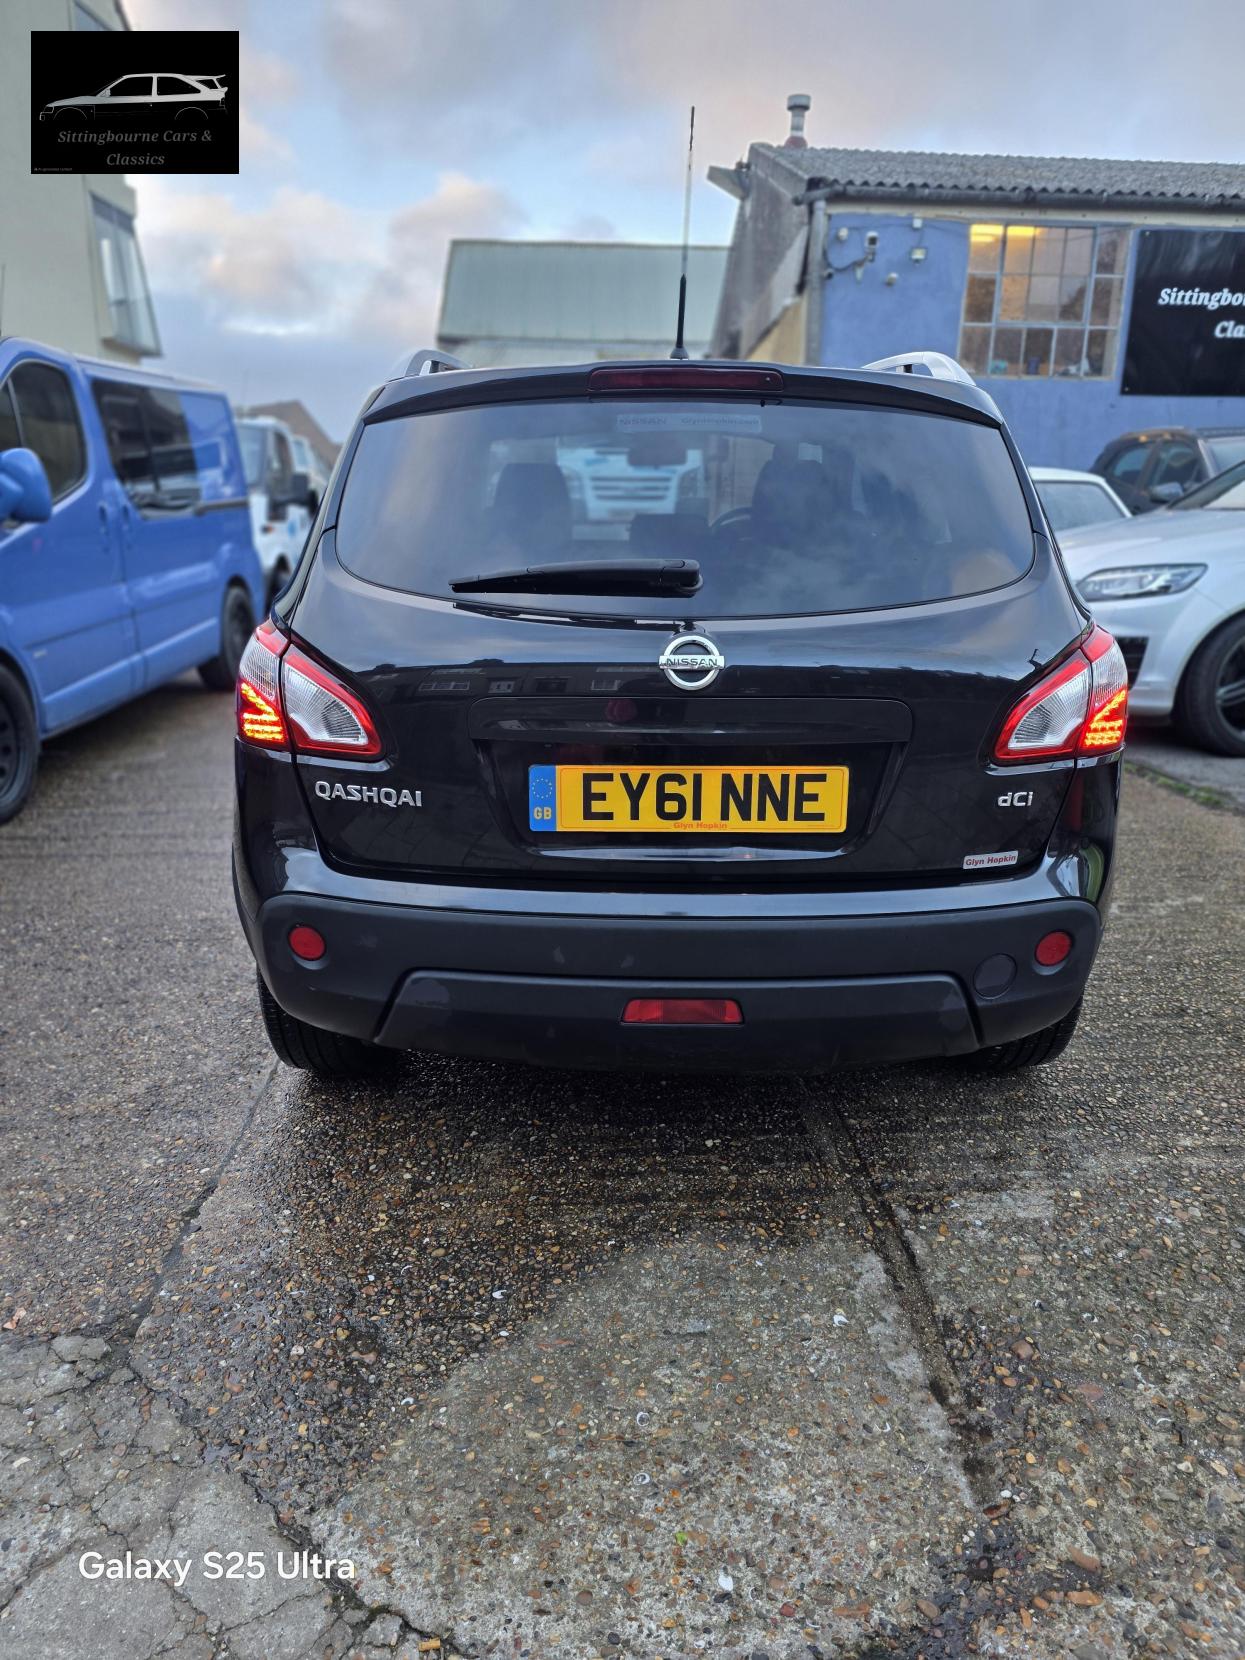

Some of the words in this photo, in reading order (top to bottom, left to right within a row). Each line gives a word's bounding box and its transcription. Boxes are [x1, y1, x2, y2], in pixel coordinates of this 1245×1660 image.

[1213, 320, 1245, 339] Cla
[666, 658, 718, 667] NISSAN
[314, 780, 423, 808] QASHQAI
[582, 772, 703, 822] EY61
[720, 773, 827, 822] NNE
[997, 791, 1034, 807] dCi
[533, 806, 552, 821] GB
[673, 821, 694, 831] Glyn
[696, 821, 728, 831] Hopkin
[965, 858, 985, 867] Glyn
[987, 854, 1016, 865] Hopkin
